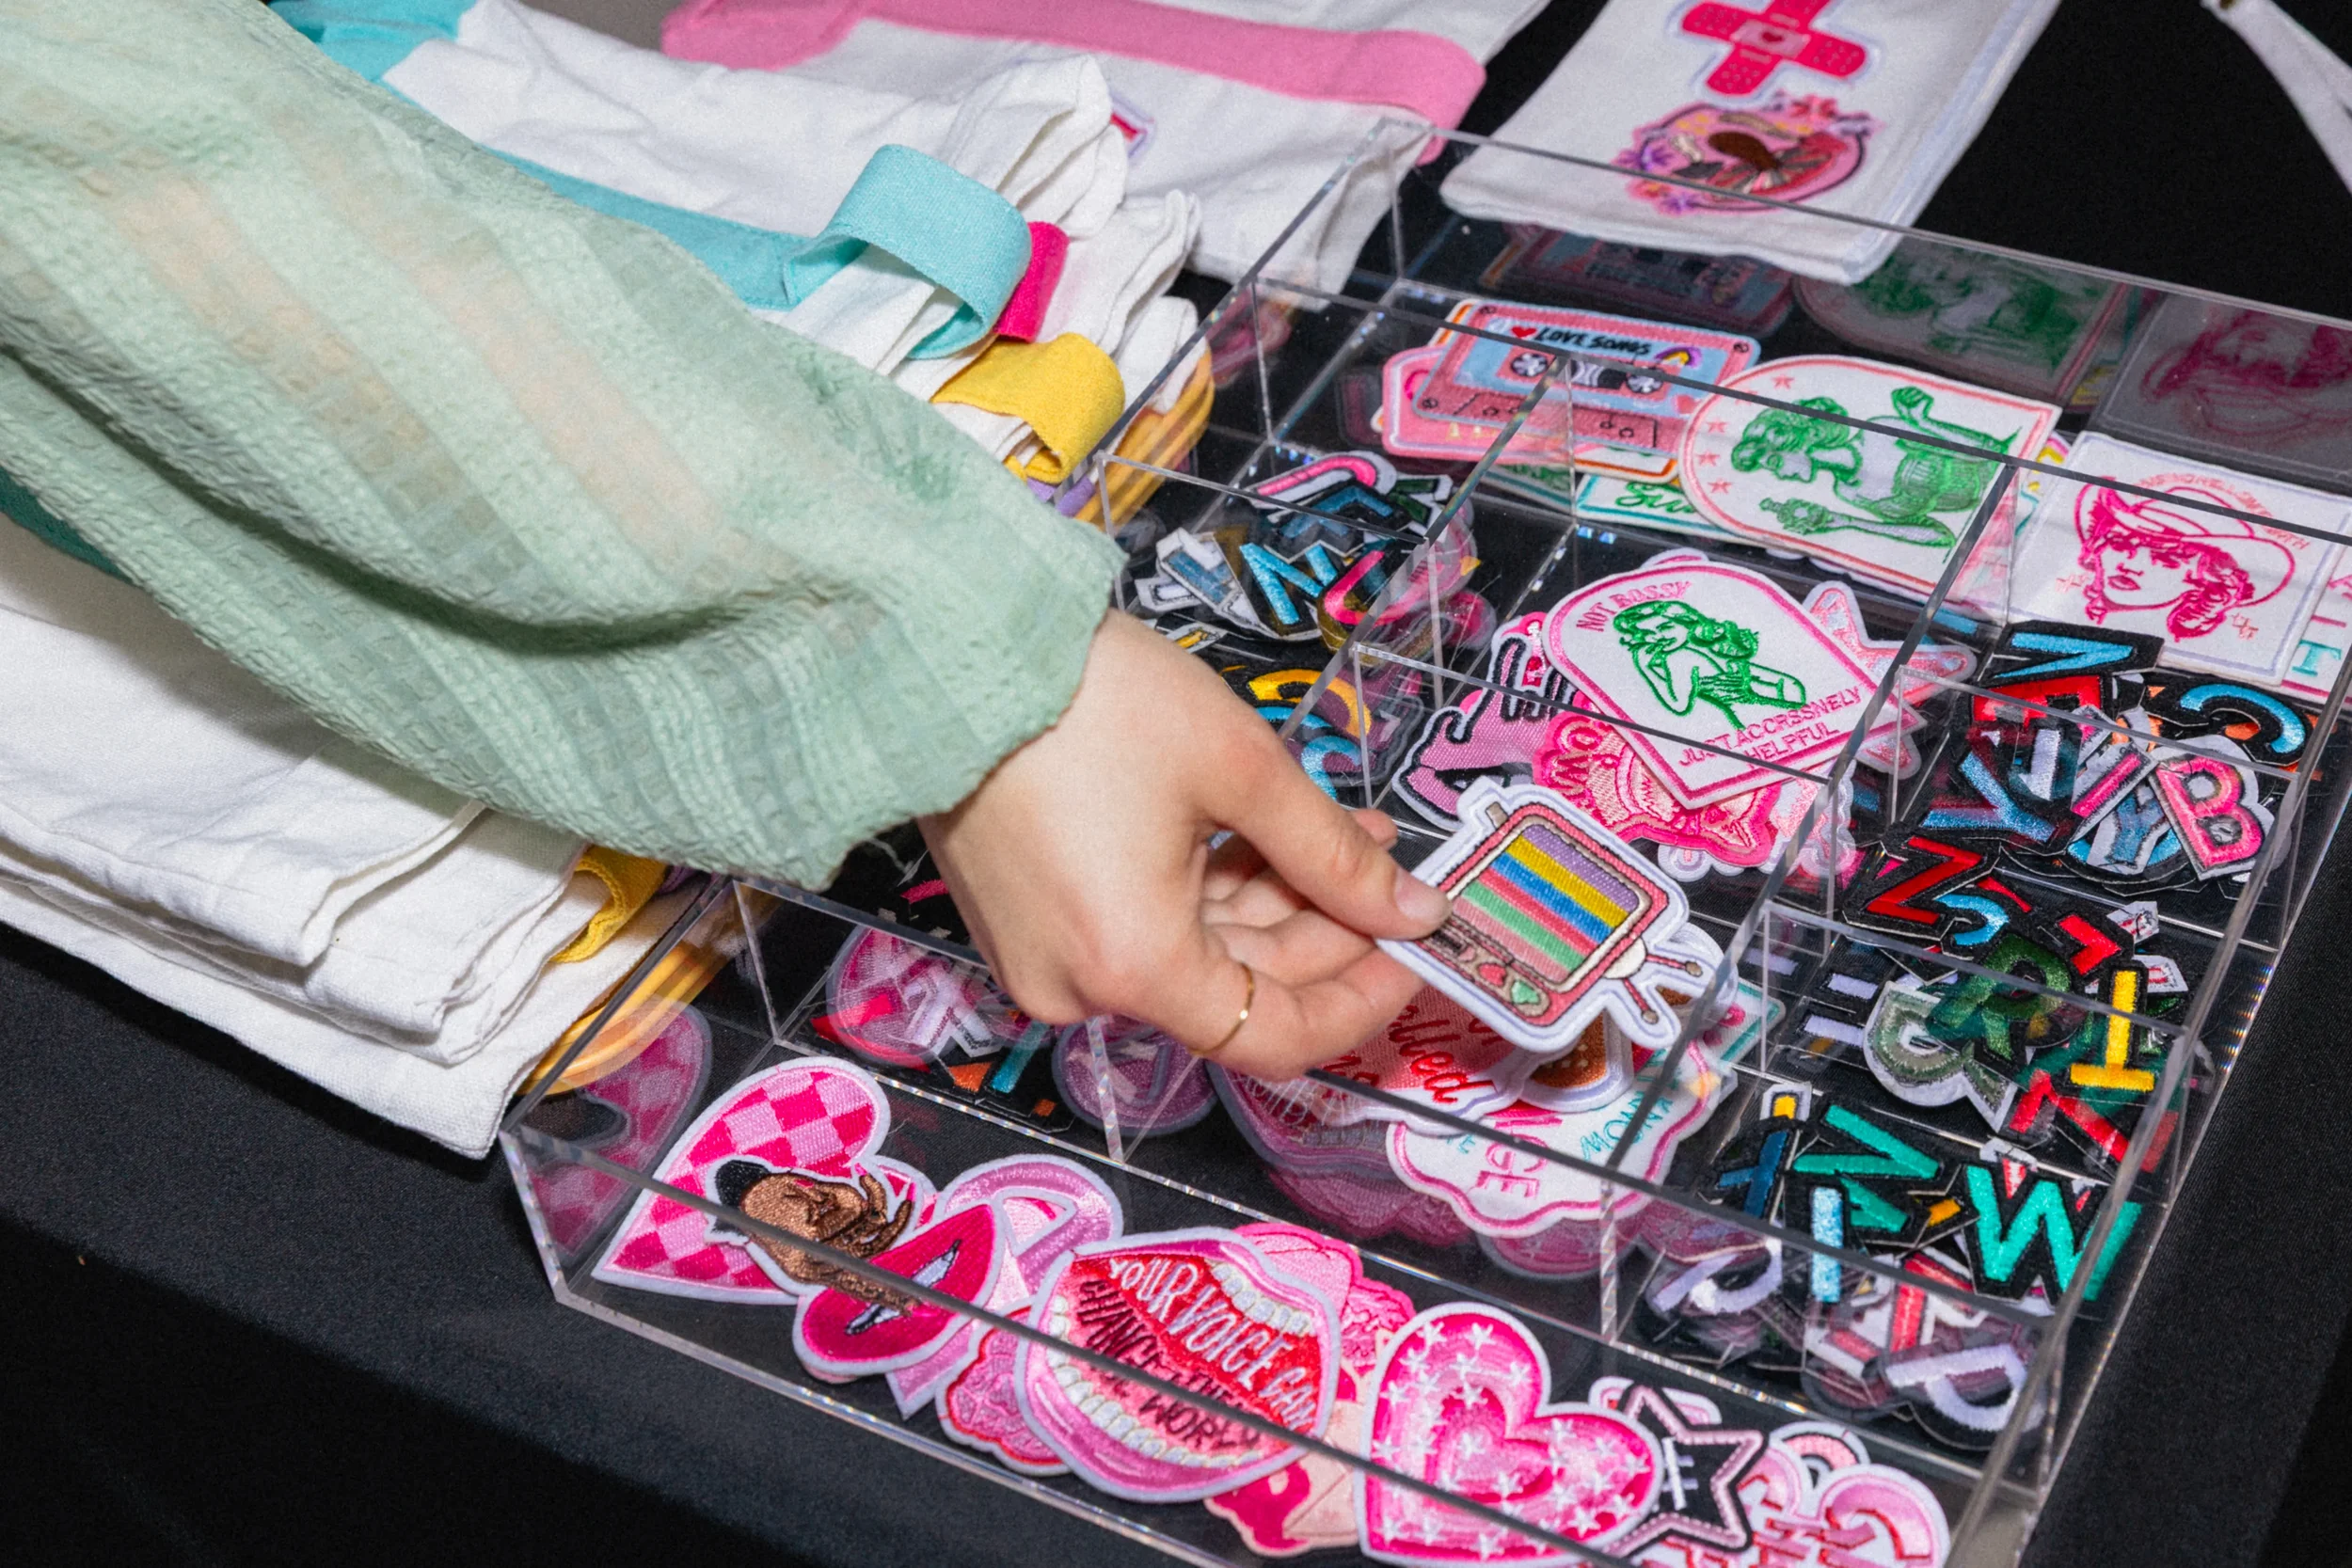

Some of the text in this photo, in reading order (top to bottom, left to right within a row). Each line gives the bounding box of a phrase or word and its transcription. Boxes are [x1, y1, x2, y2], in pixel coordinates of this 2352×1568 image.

[1536, 326, 1652, 356] LOVE SONGS
[1576, 581, 1692, 633] NOT BOSSY
[1744, 722, 1840, 769] HELPFUL
[2155, 755, 2264, 868] B
[1968, 1165, 2143, 1301] W
[1109, 1258, 1199, 1323] YOUR
[1168, 1284, 1294, 1391] VOICE
[1258, 1367, 1316, 1431] CAN
